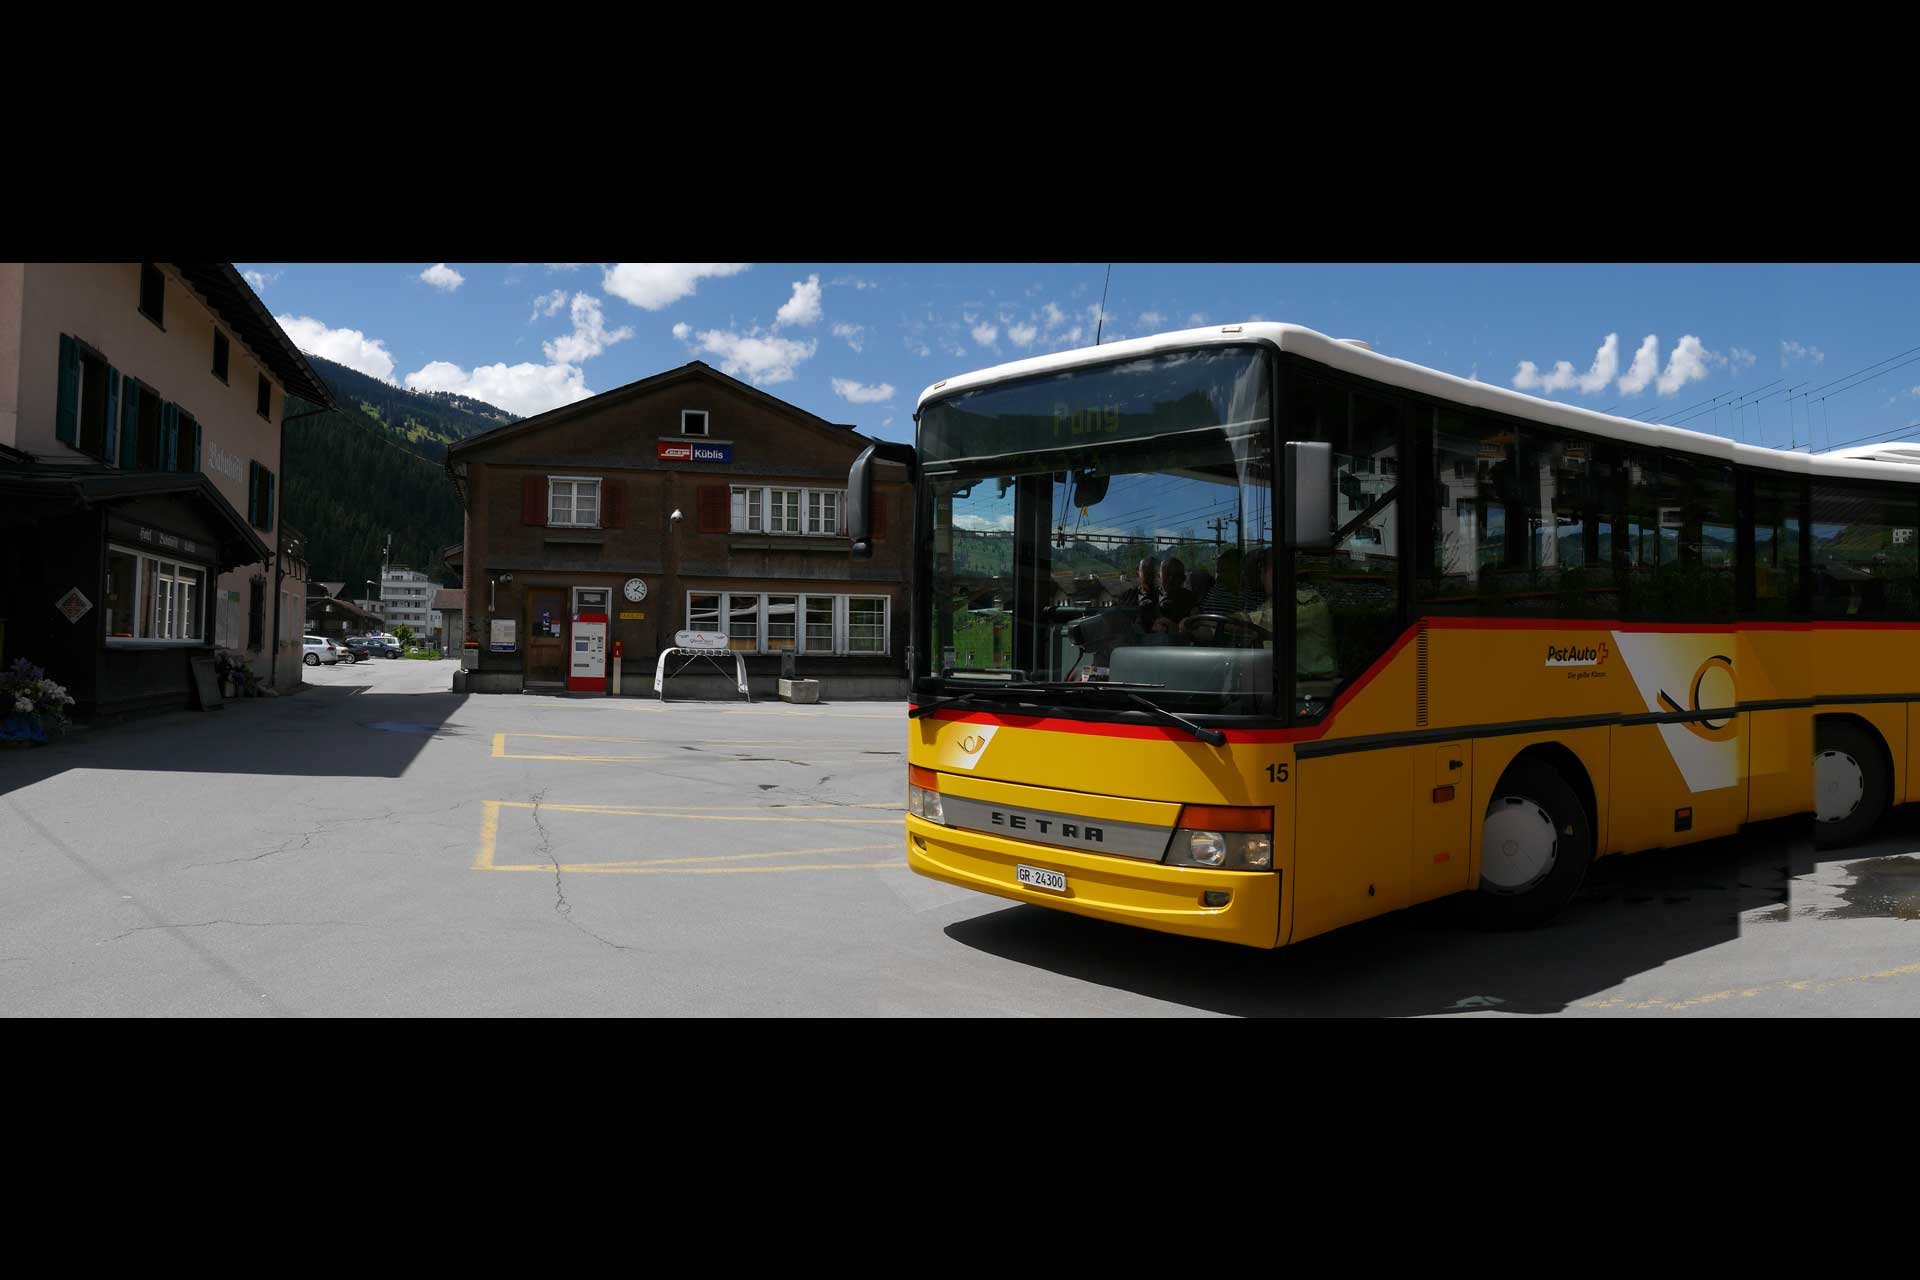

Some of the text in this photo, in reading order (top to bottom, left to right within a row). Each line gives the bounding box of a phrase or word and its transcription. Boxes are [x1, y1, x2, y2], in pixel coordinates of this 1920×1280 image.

[694, 448, 724, 460] Küblis
[1265, 763, 1289, 783] 15
[991, 811, 1104, 842] SETRA
